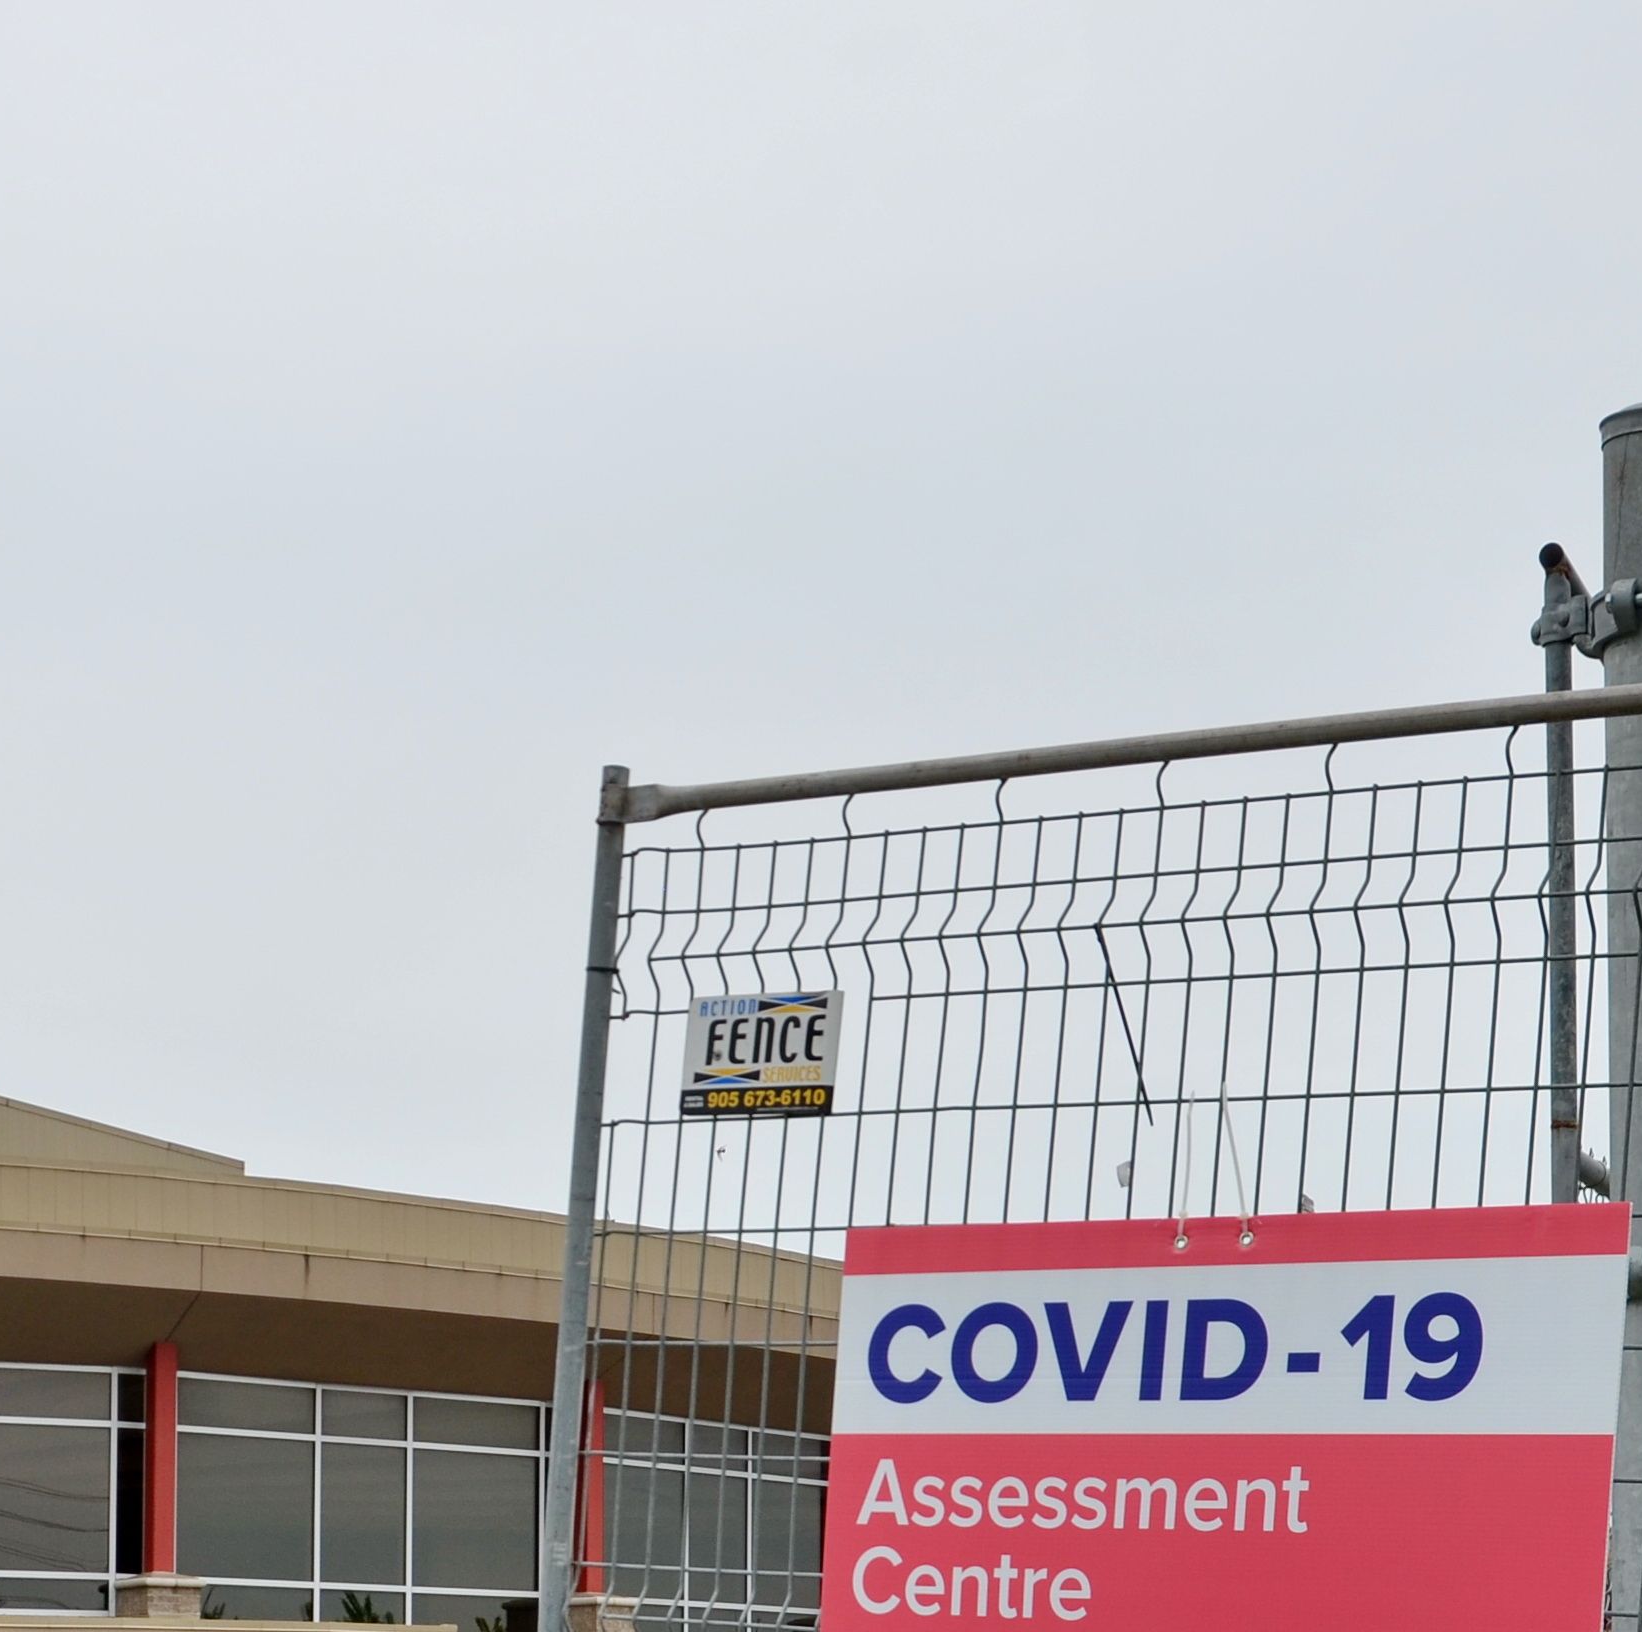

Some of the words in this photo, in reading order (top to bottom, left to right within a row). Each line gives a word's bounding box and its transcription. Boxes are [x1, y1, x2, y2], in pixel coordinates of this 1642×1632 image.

[700, 998, 757, 1017] ACTION
[761, 1065, 822, 1084] SERVICES
[708, 1090, 739, 1108] 905
[743, 1088, 826, 1107] 673-6110
[856, 1457, 1310, 1534] Assessment
[851, 1545, 1092, 1621] Centre
